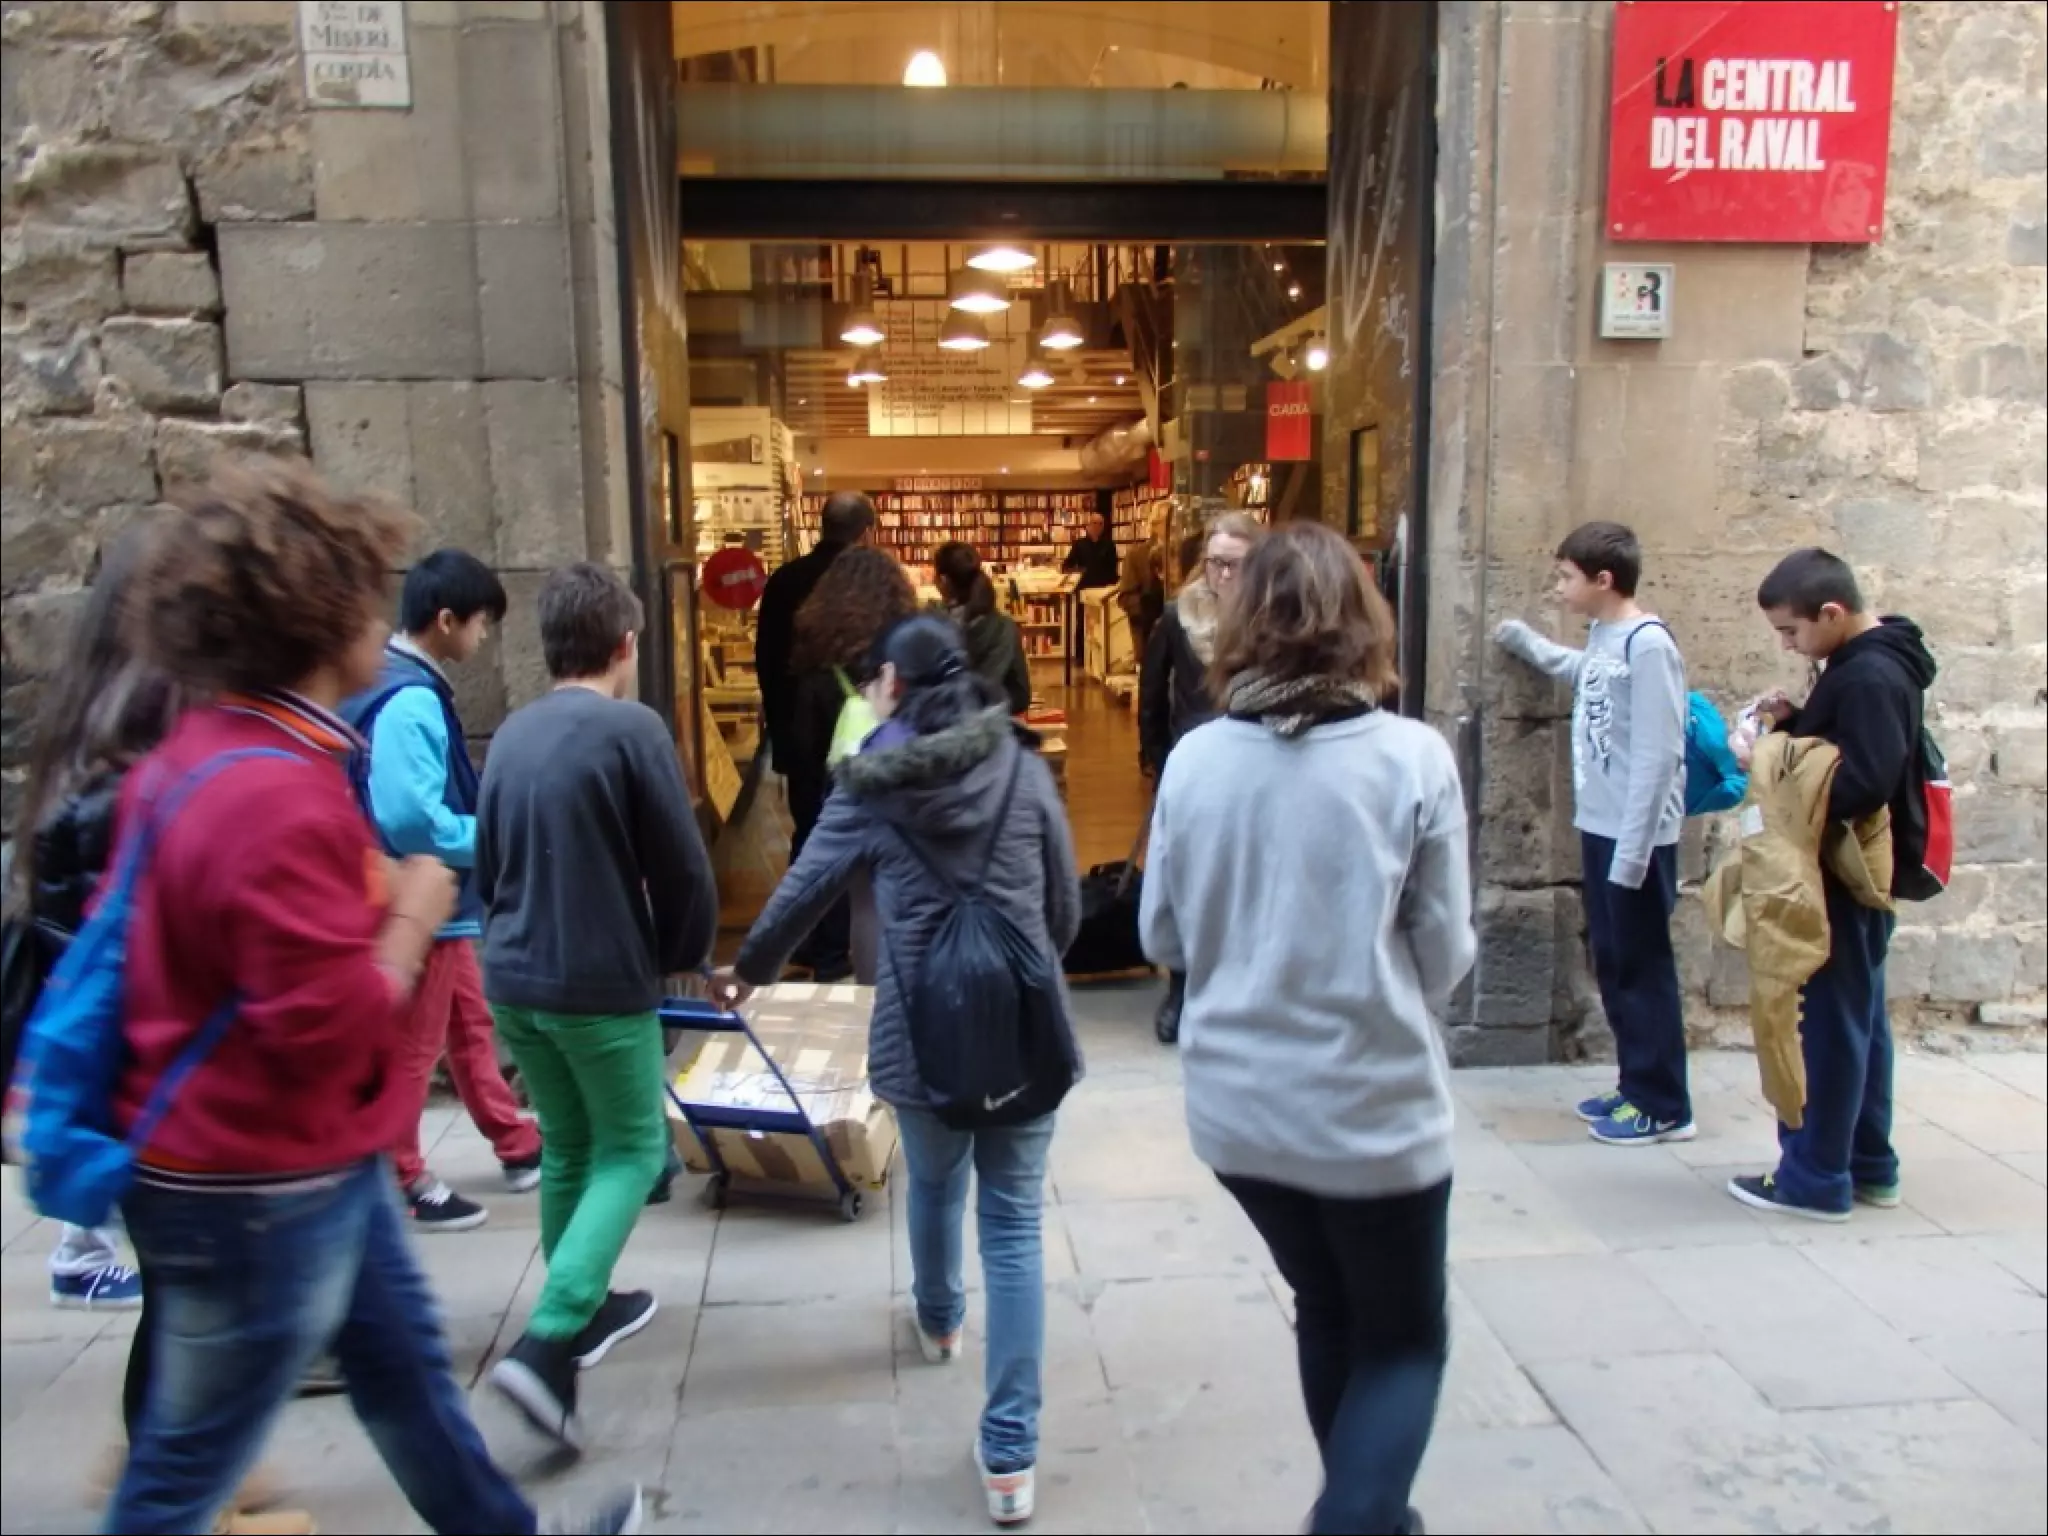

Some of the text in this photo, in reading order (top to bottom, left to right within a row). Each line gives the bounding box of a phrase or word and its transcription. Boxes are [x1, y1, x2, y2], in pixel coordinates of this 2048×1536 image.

[1655, 57, 1857, 112] LA CENTRAL
[1650, 115, 1826, 171] DEL RAVAL
